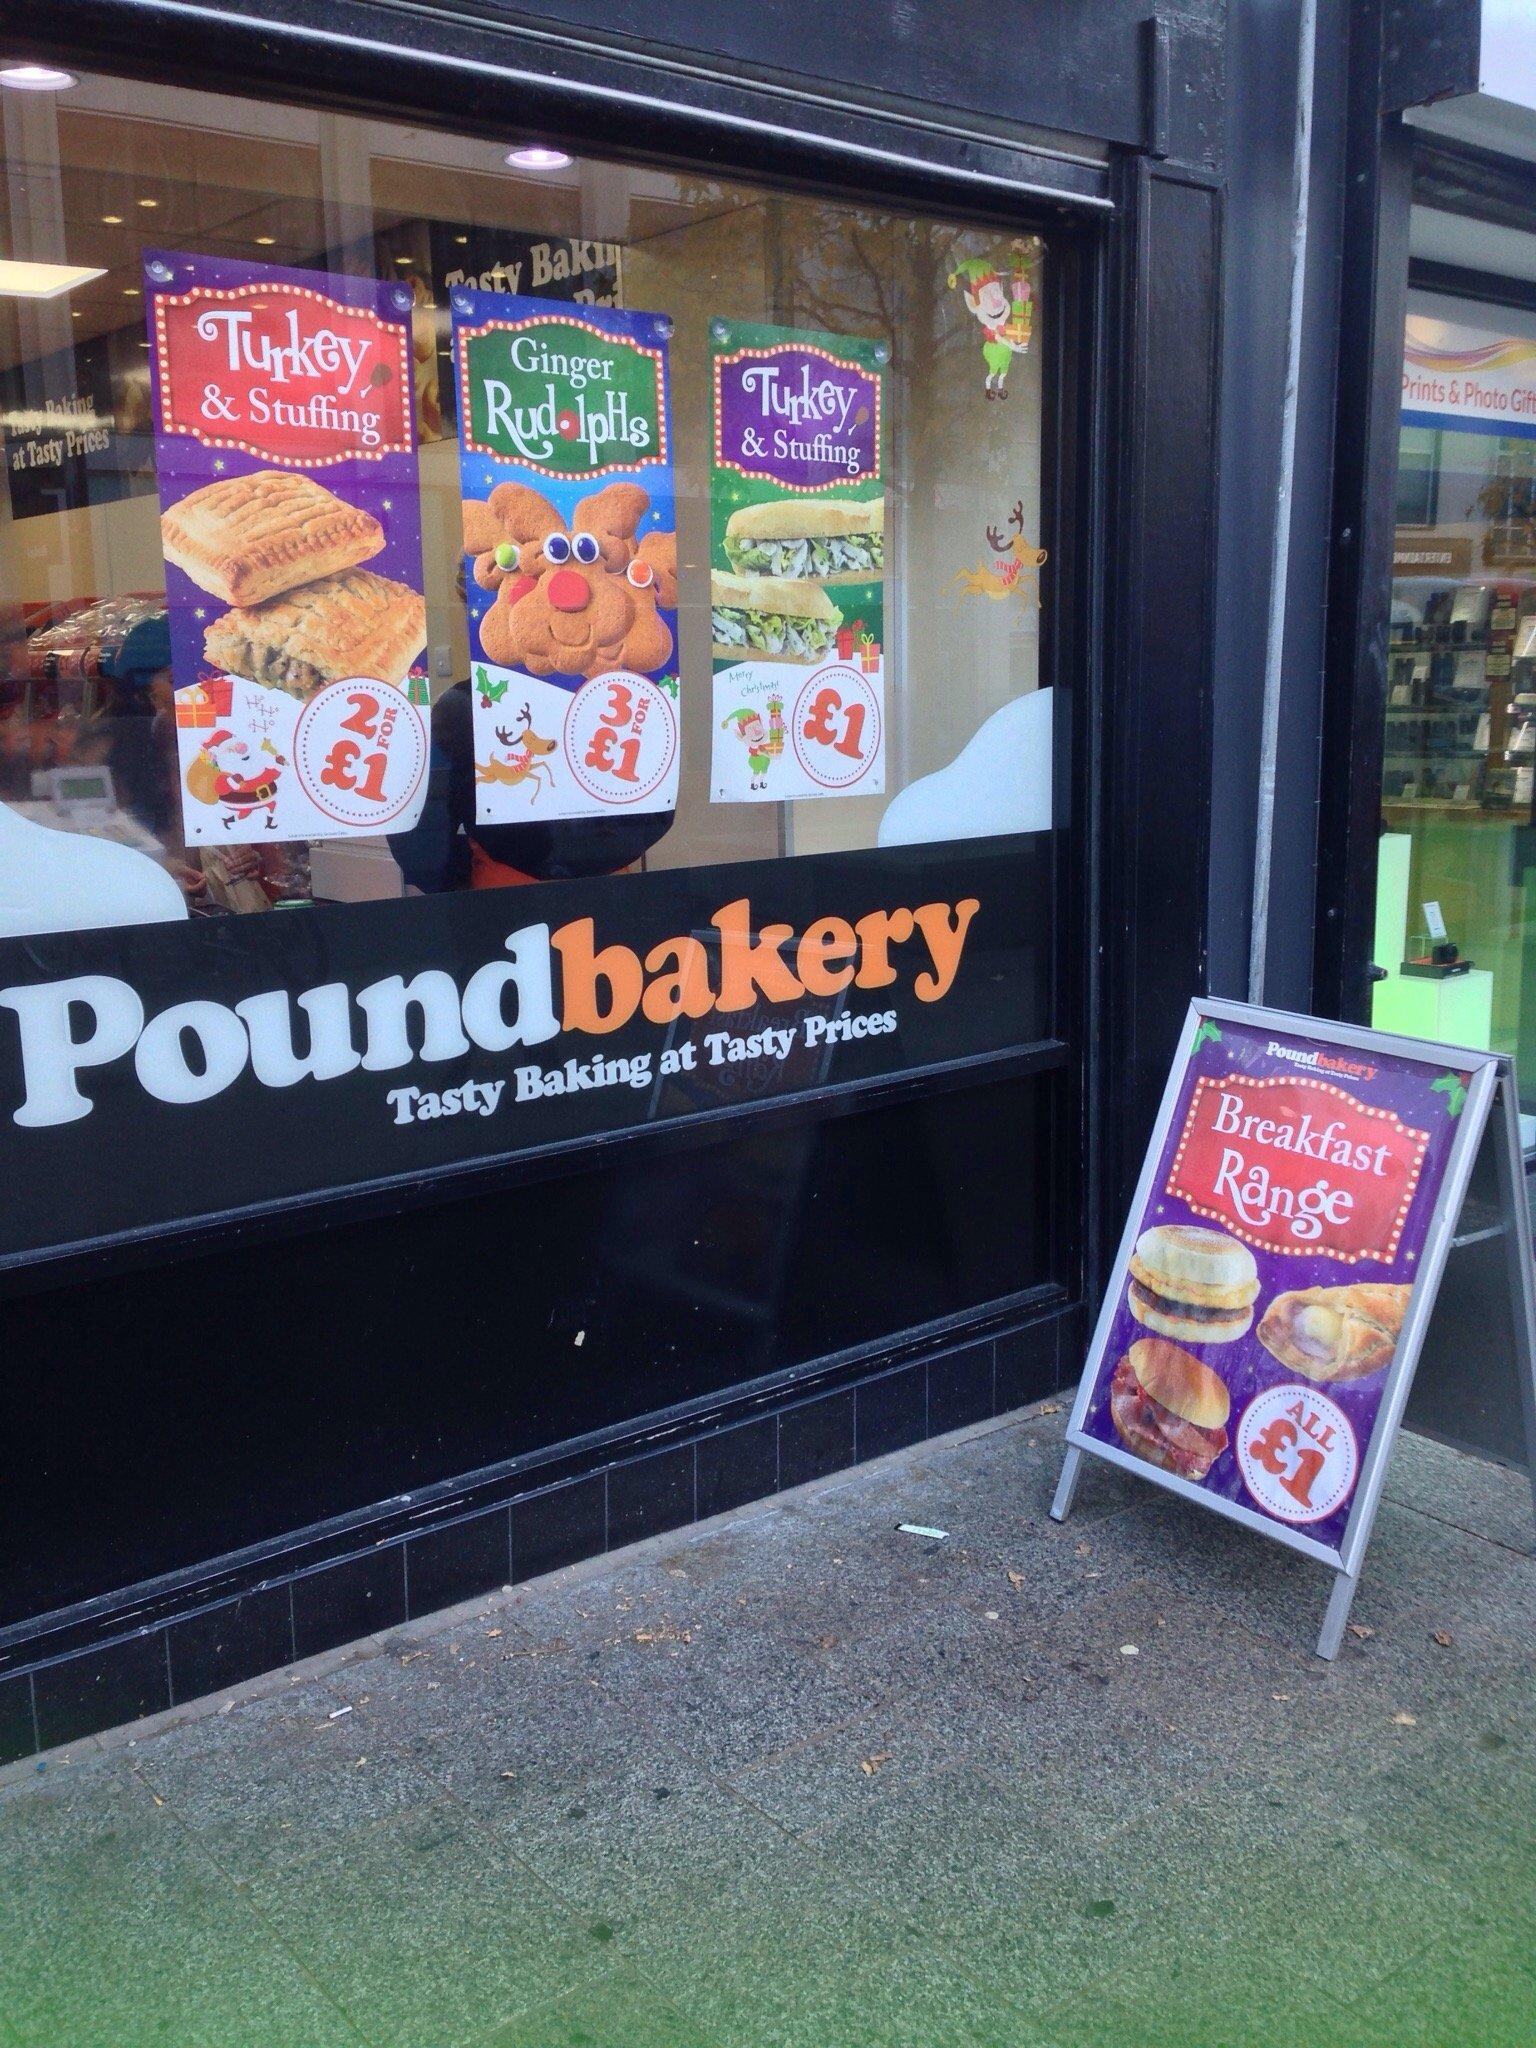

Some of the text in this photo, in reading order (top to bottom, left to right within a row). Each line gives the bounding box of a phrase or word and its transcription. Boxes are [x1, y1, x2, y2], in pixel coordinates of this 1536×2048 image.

[197, 309, 372, 394] Turkey
[511, 337, 614, 389] Ginger
[201, 384, 381, 445] & Stuffing
[742, 364, 857, 433] Turkey
[1401, 374, 1445, 402] Prints
[1449, 380, 1460, 404] &
[1464, 381, 1507, 410] Photo
[13, 429, 110, 471] at Tasty Prices
[741, 428, 861, 474] & Stuffing
[340, 693, 398, 750] 2 FOR
[599, 684, 650, 735] 3 FOR
[803, 688, 866, 759] £1
[320, 740, 388, 802] £1
[585, 727, 641, 782] £1
[0, 898, 980, 1127] Poundbakery
[386, 1080, 505, 1125] Tasty
[514, 1053, 653, 1103] Baking
[659, 1041, 698, 1075] at
[703, 1027, 798, 1066] Tasty
[804, 1009, 898, 1048] Prices
[1211, 1092, 1393, 1177] Breakfast
[1213, 1148, 1354, 1239] Range
[1286, 1401, 1336, 1452] ALL
[1249, 1419, 1326, 1508] £1
